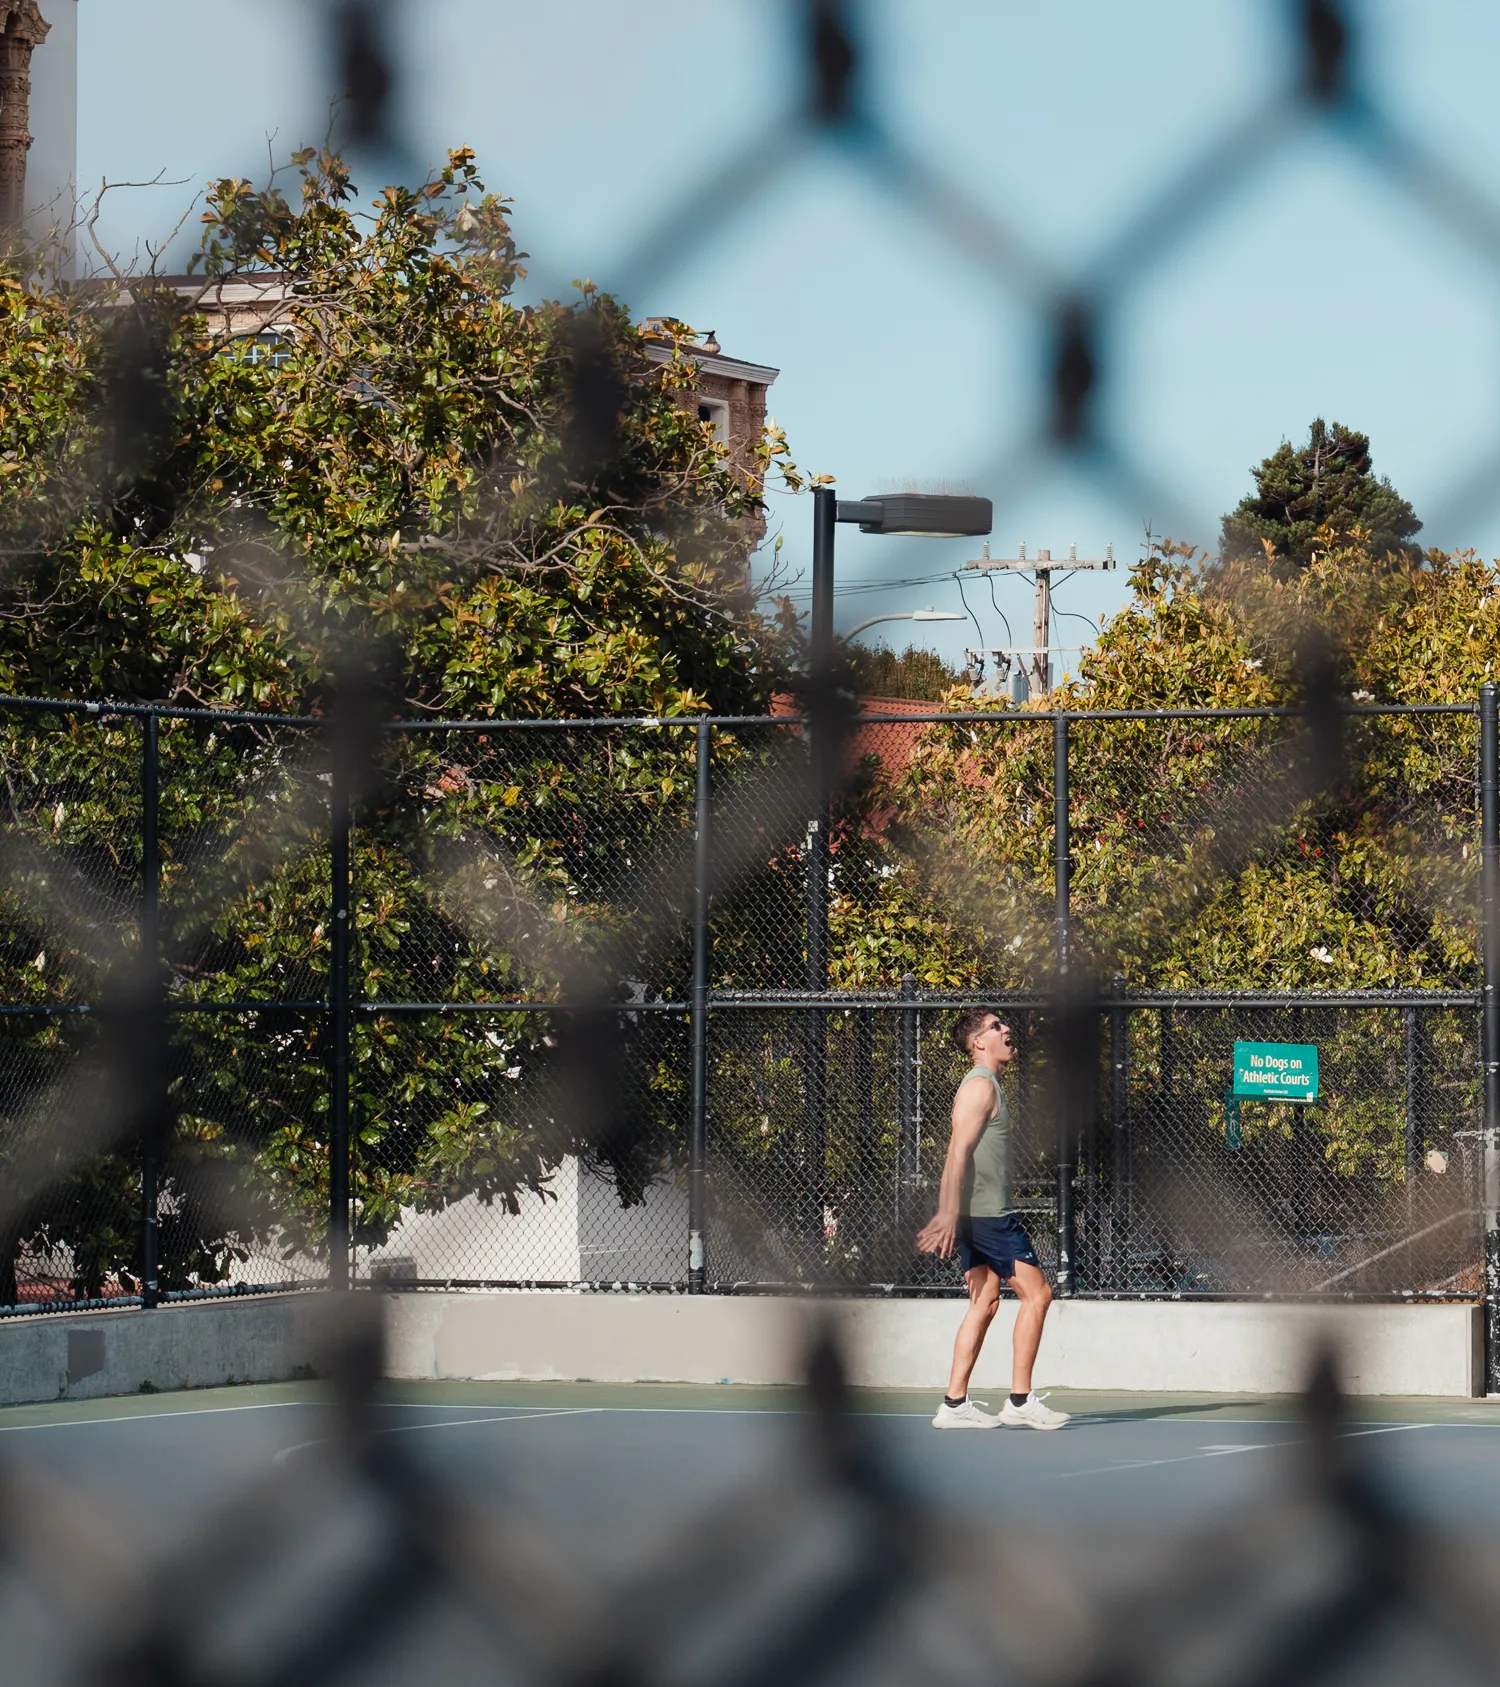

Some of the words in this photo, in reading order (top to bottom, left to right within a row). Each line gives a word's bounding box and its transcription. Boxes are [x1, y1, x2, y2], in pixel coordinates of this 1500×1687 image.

[1250, 1054, 1264, 1068] No
[1265, 1055, 1288, 1071] Dogs
[1290, 1059, 1302, 1069] on
[1242, 1070, 1279, 1084] Athletic
[1280, 1072, 1310, 1085] Courts
